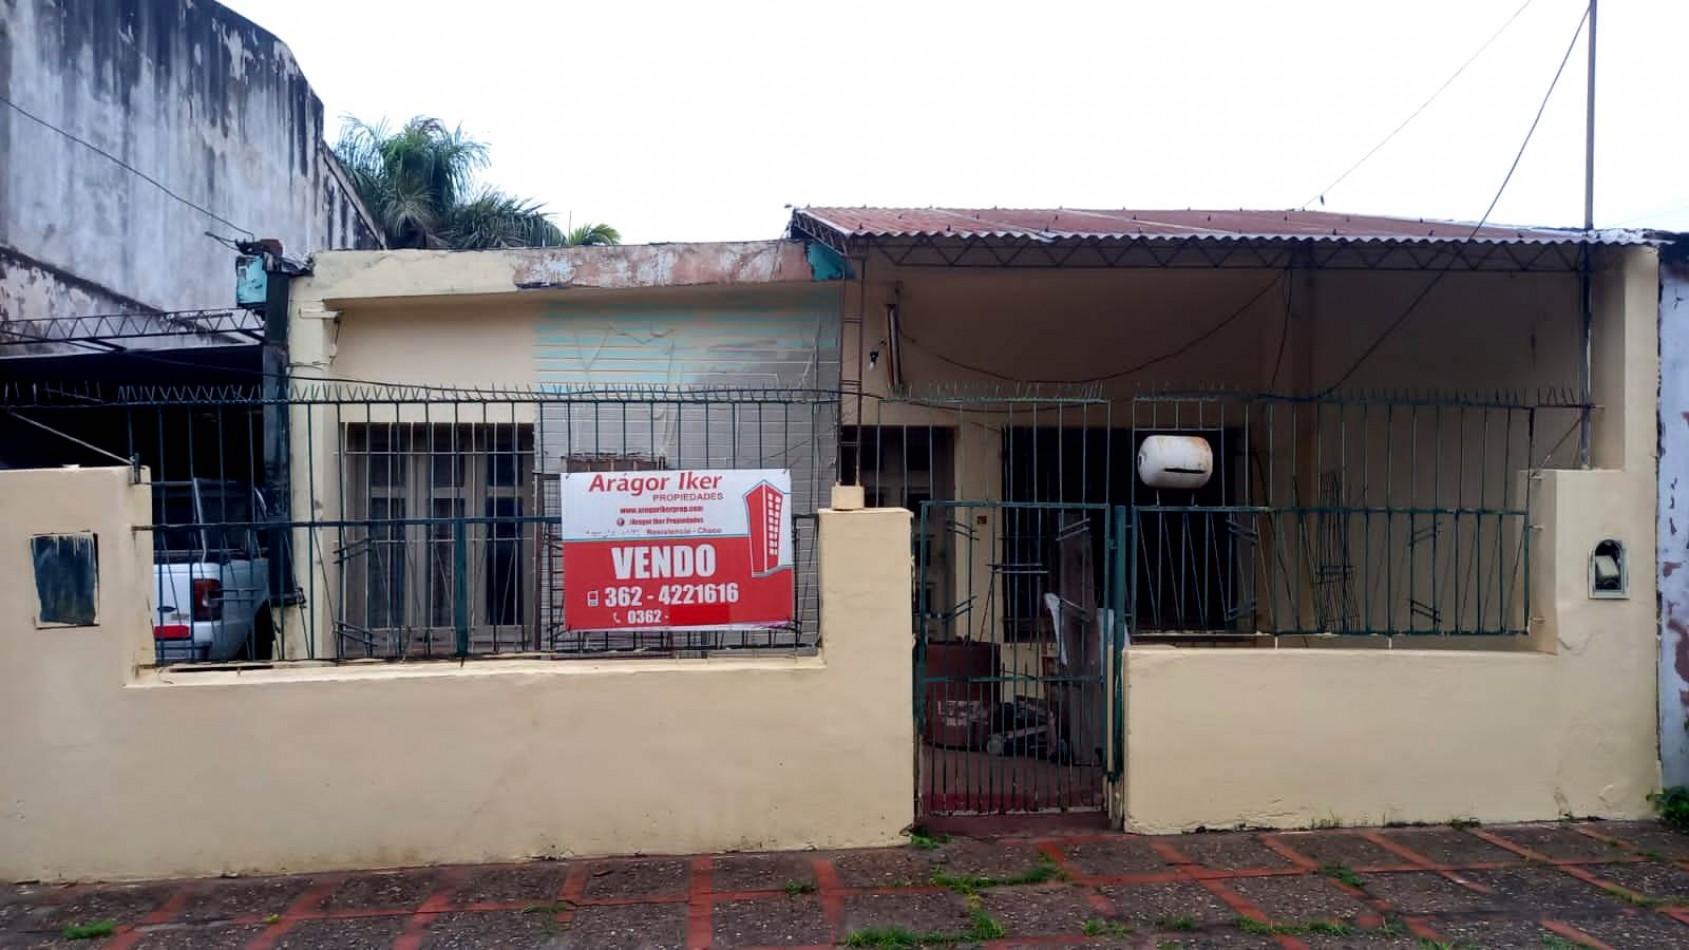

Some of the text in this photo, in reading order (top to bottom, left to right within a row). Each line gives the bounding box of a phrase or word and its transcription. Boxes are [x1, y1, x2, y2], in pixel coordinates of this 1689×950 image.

[678, 471, 723, 490] Iker
[653, 492, 724, 502] PROPIEDADES
[698, 527, 723, 535] Chaco
[611, 543, 716, 580] VENDO
[604, 586, 643, 608] 362
[658, 582, 739, 606] 4221616
[627, 609, 662, 625] 0362
